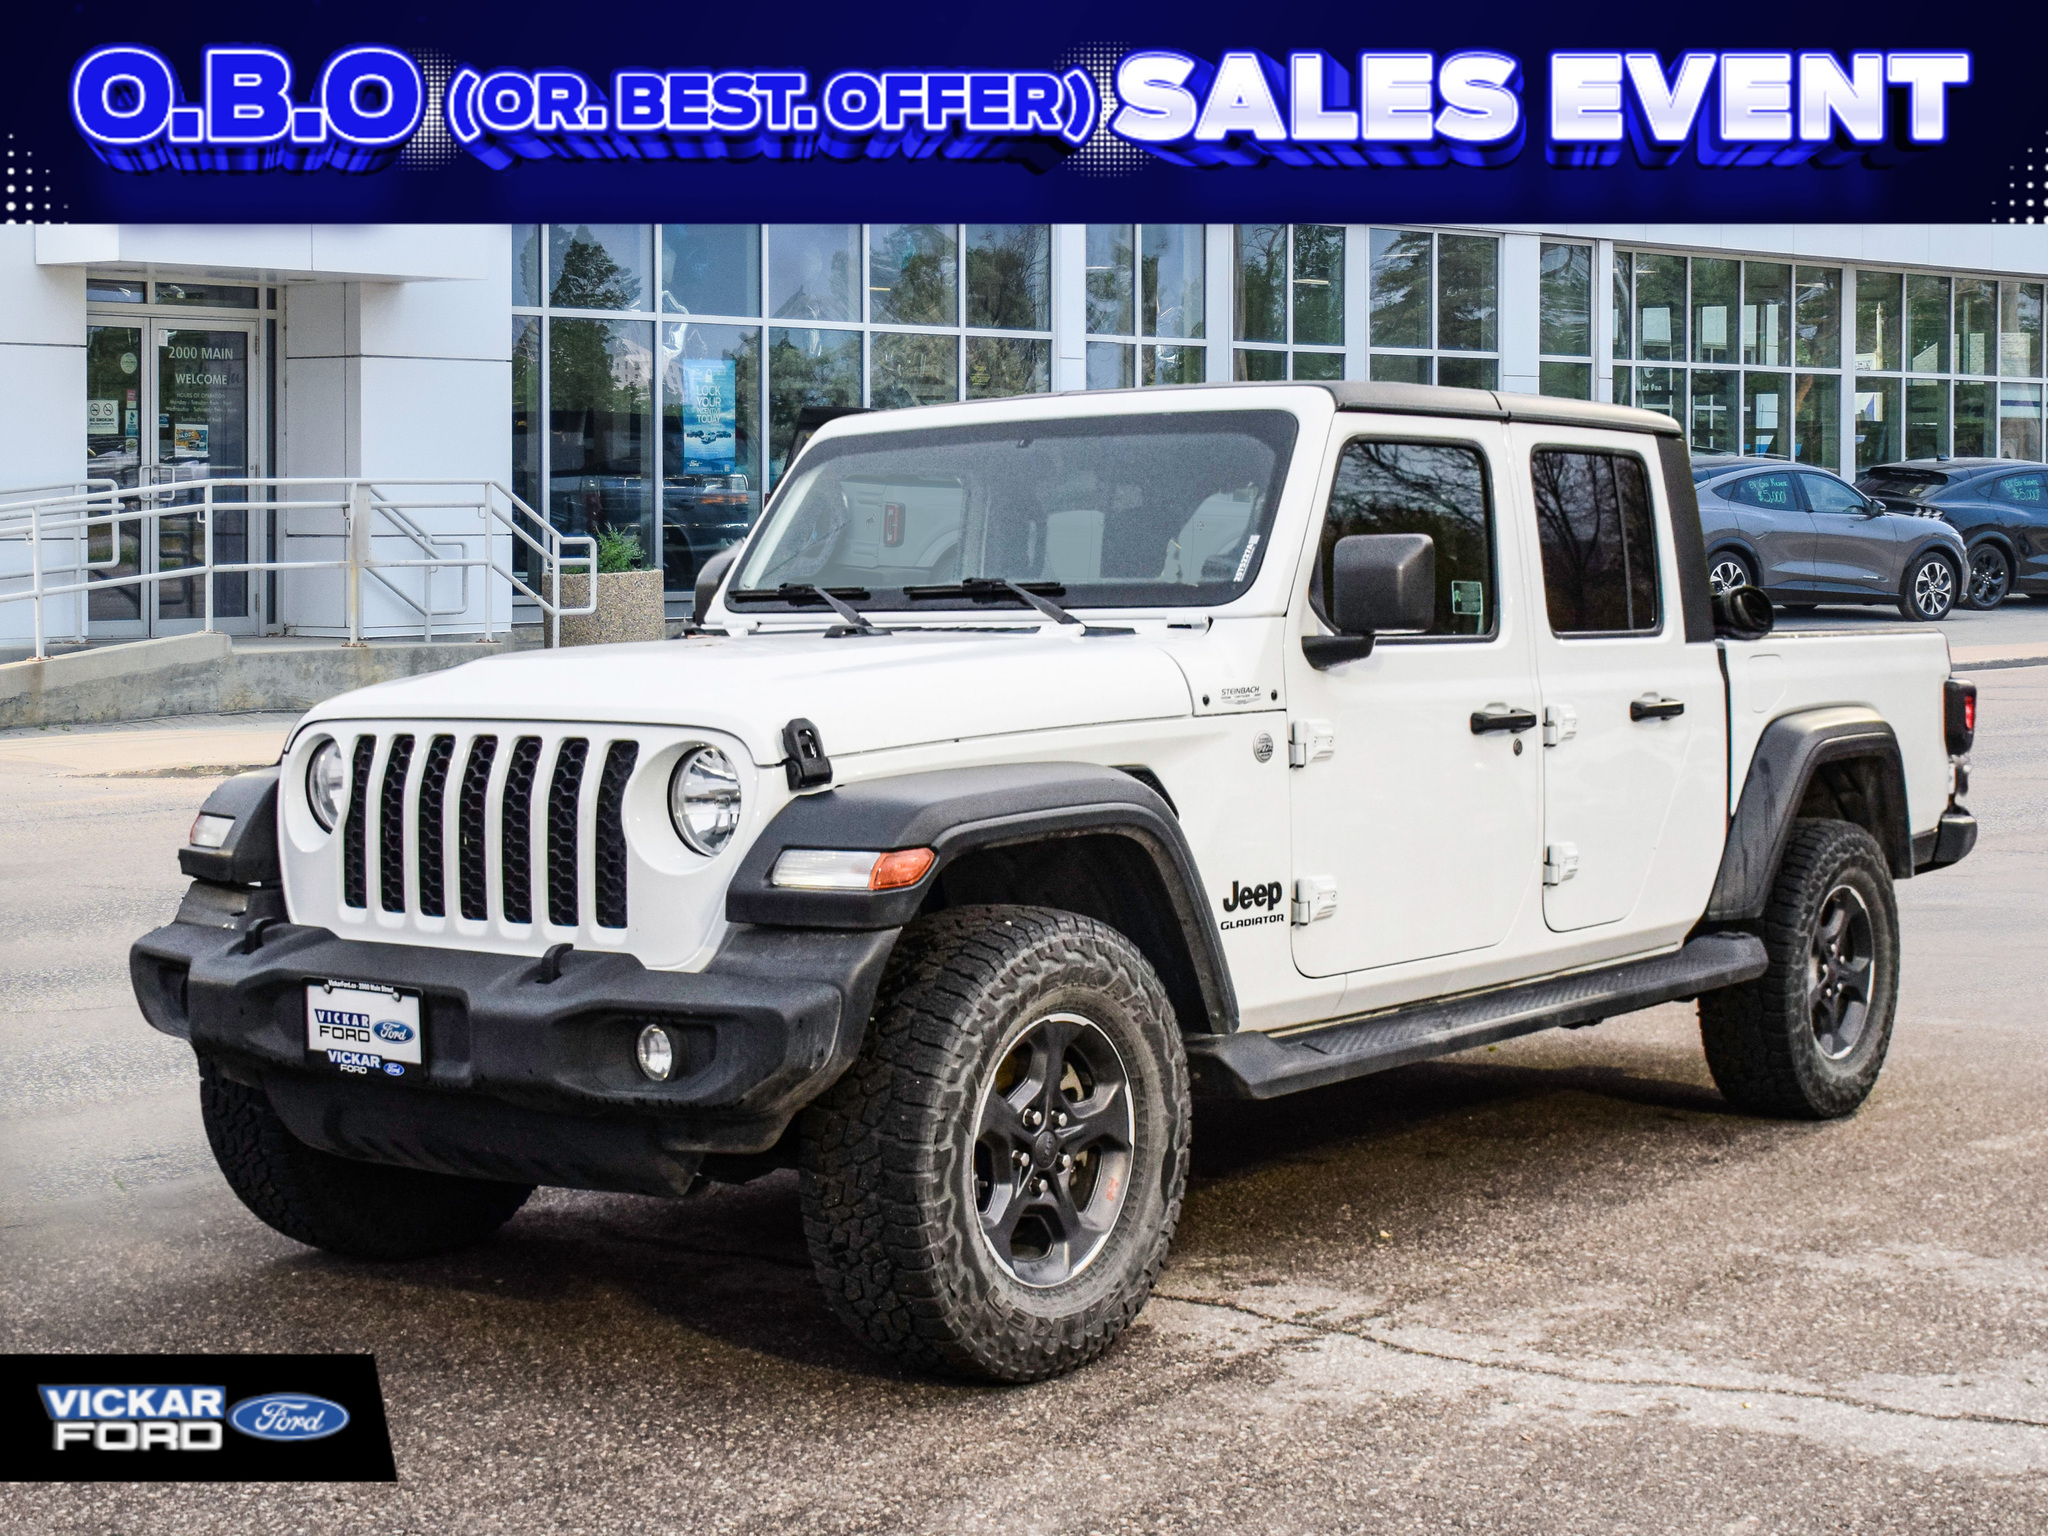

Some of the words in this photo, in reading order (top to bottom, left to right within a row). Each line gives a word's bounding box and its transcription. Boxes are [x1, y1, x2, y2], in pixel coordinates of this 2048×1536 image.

[168, 346, 198, 359] 2000
[201, 347, 233, 360] MAIN
[175, 373, 228, 386] WELCOME
[696, 385, 721, 396] LOCK
[696, 396, 722, 408] YOUR
[697, 414, 721, 424] TODAY
[1221, 686, 1260, 696] STEINBACH
[1223, 880, 1282, 912] Jeep
[1220, 913, 1284, 930] GLADIATOR
[316, 1010, 370, 1028] VICKAR
[320, 1025, 370, 1043] FORD
[380, 1022, 407, 1041] Ford
[327, 1050, 381, 1069] VICKAR
[340, 1064, 368, 1075] FORD
